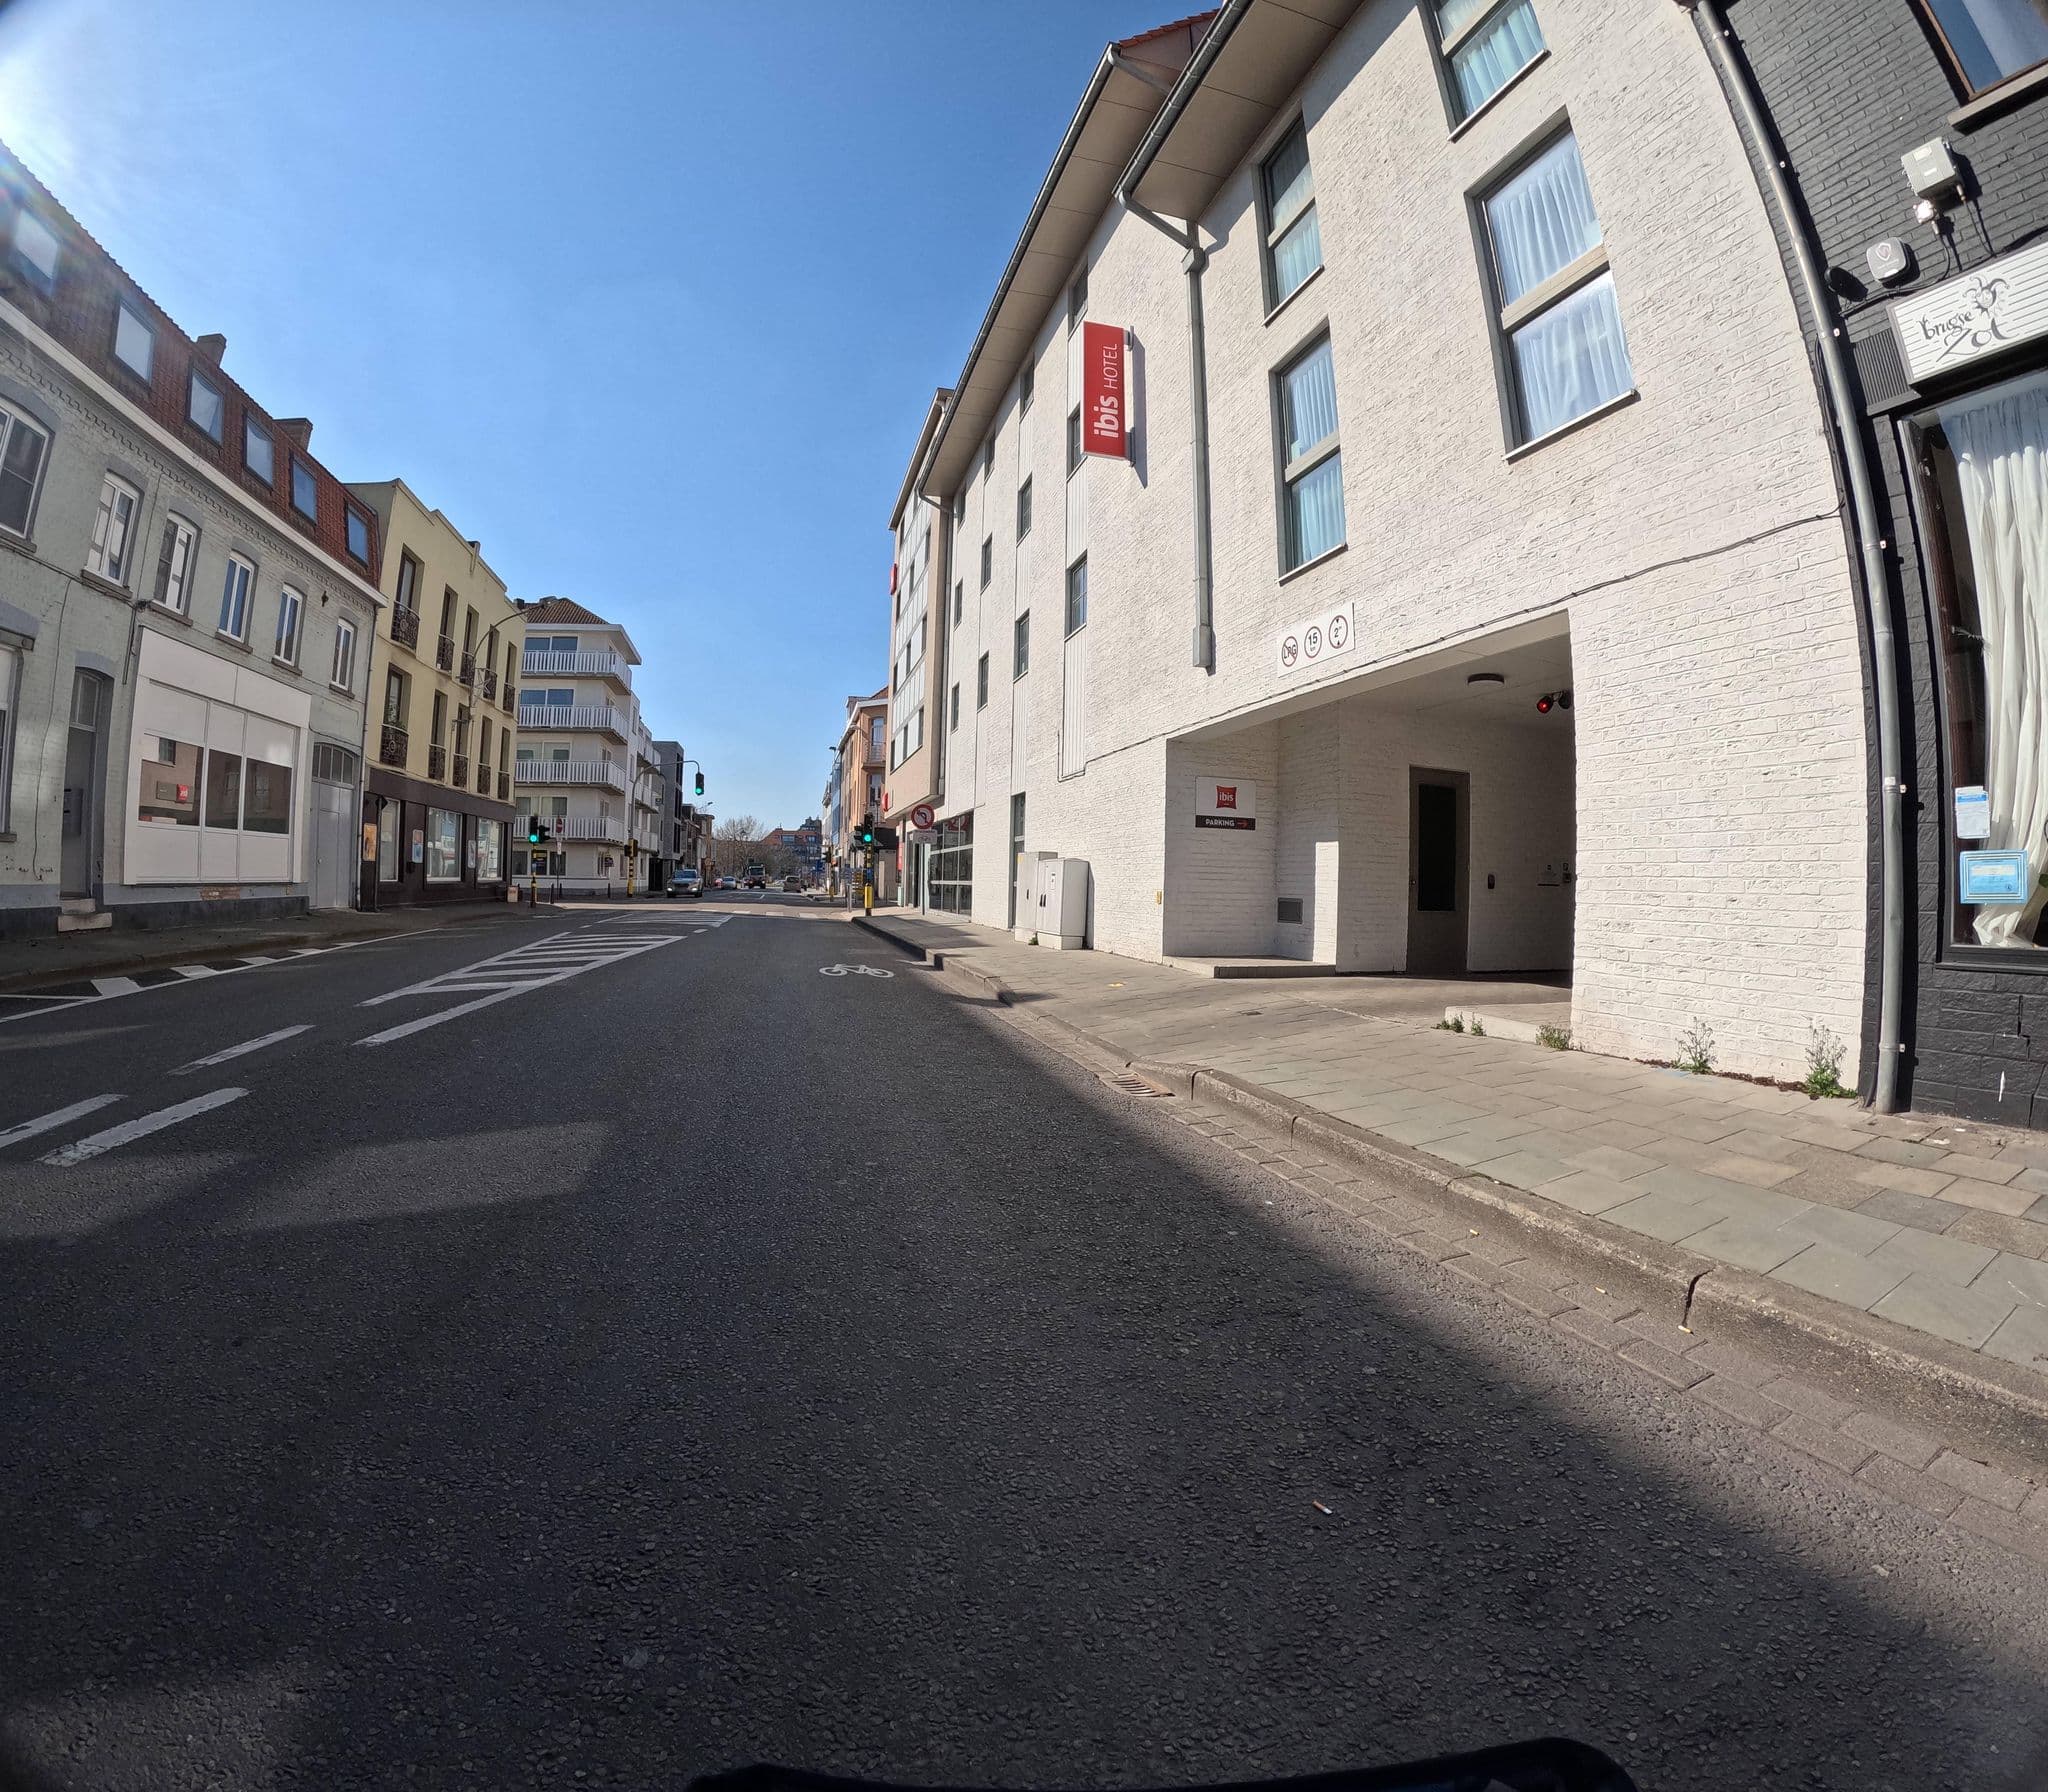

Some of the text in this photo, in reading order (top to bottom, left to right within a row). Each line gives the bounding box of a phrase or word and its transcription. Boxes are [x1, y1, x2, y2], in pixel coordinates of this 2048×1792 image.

[1917, 310, 1975, 340] brugse
[1093, 343, 1119, 438] ibis HOTEL
[1308, 632, 1318, 646] 15
[1219, 791, 1234, 802] ibis
[1205, 818, 1235, 827] PARKING
